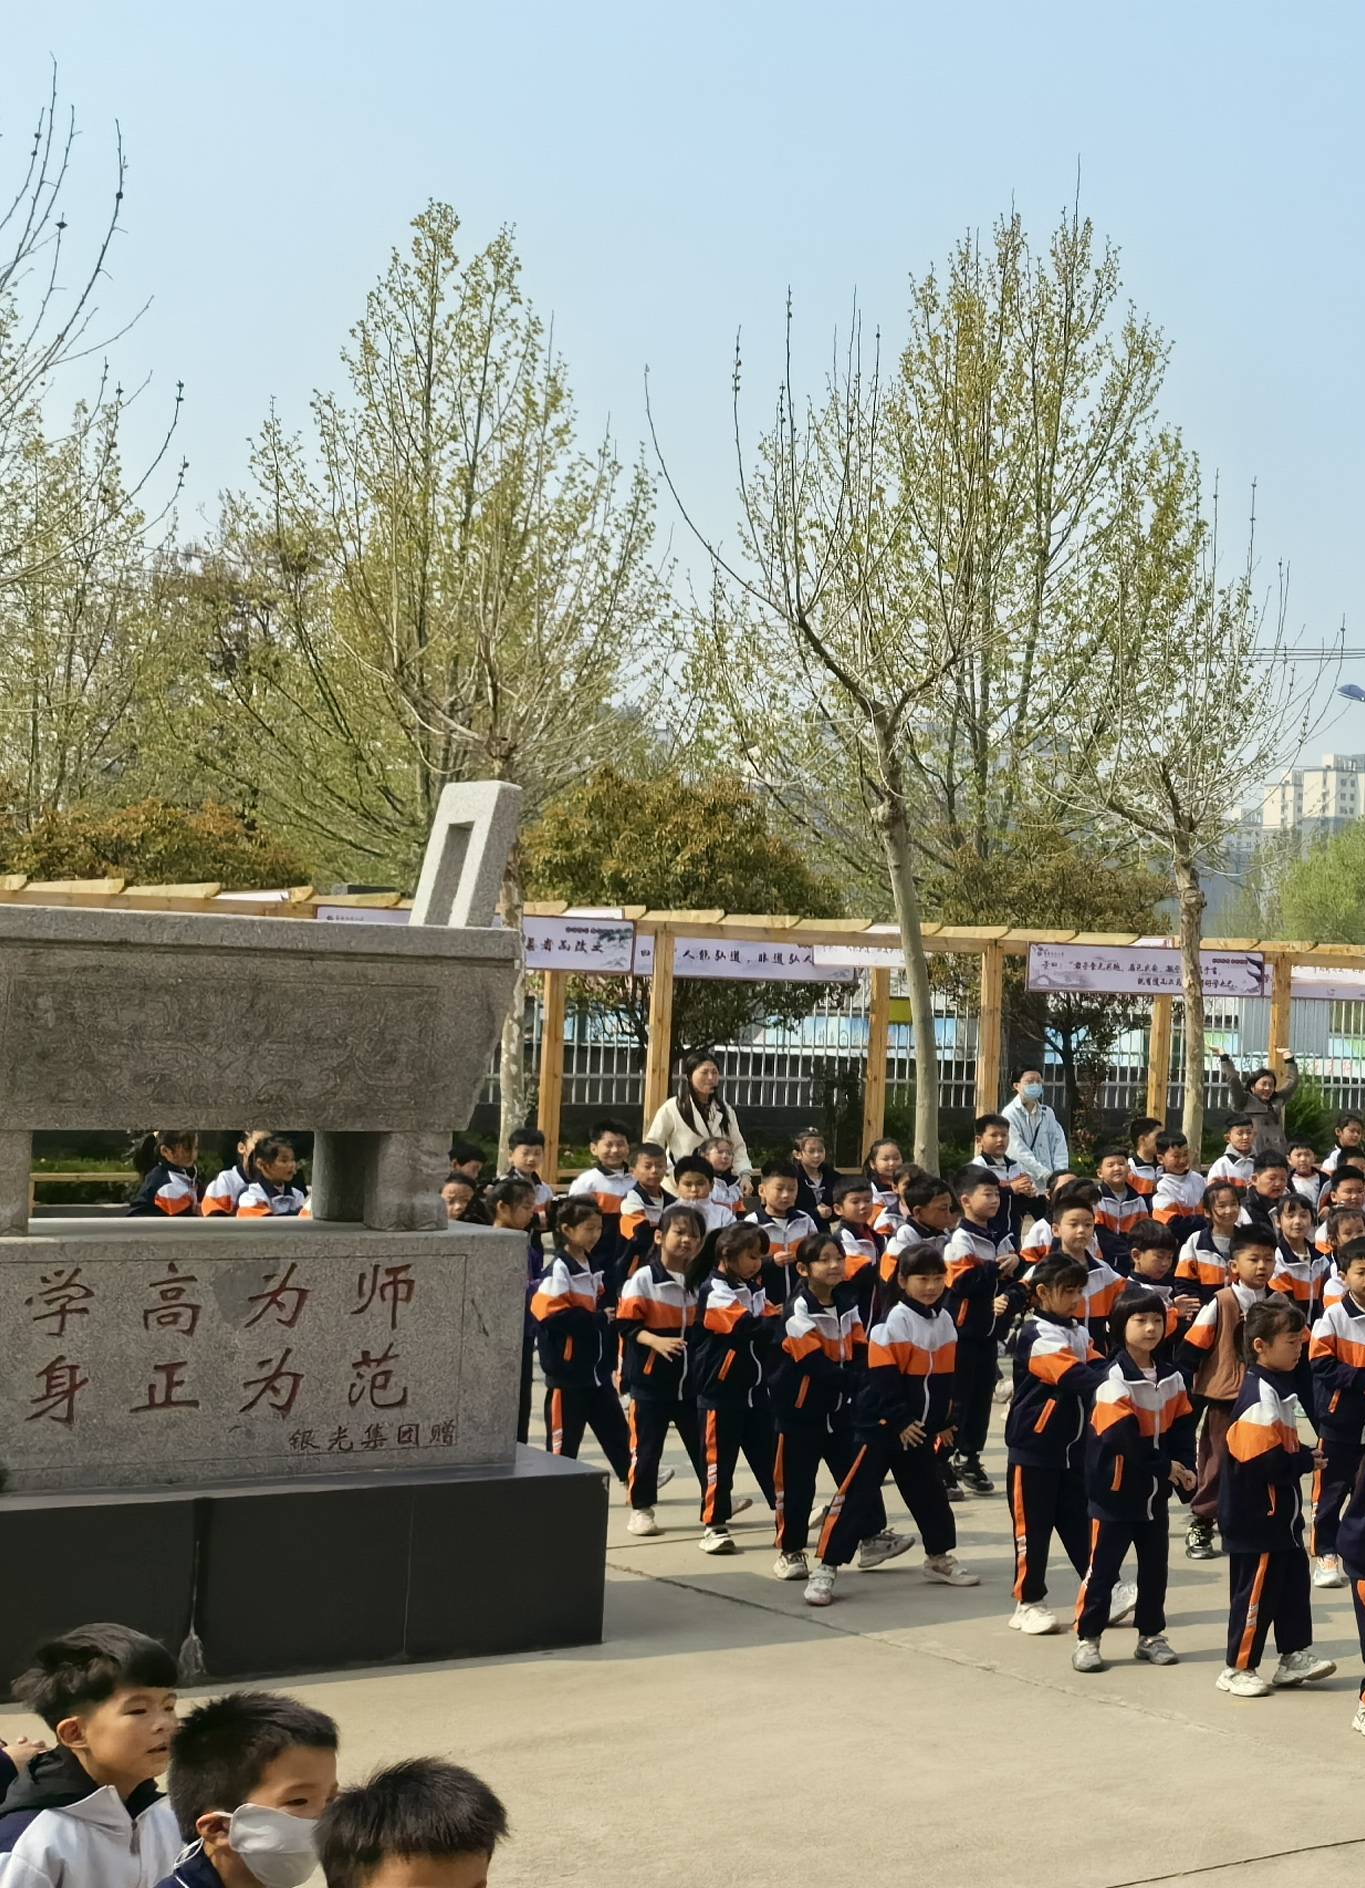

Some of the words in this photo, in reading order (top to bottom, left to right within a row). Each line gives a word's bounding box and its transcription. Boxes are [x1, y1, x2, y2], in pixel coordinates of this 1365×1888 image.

[25, 1263, 415, 1337] 学高为师
[25, 1342, 408, 1424] 身正为范
[288, 1419, 456, 1451] 银光集团赠
